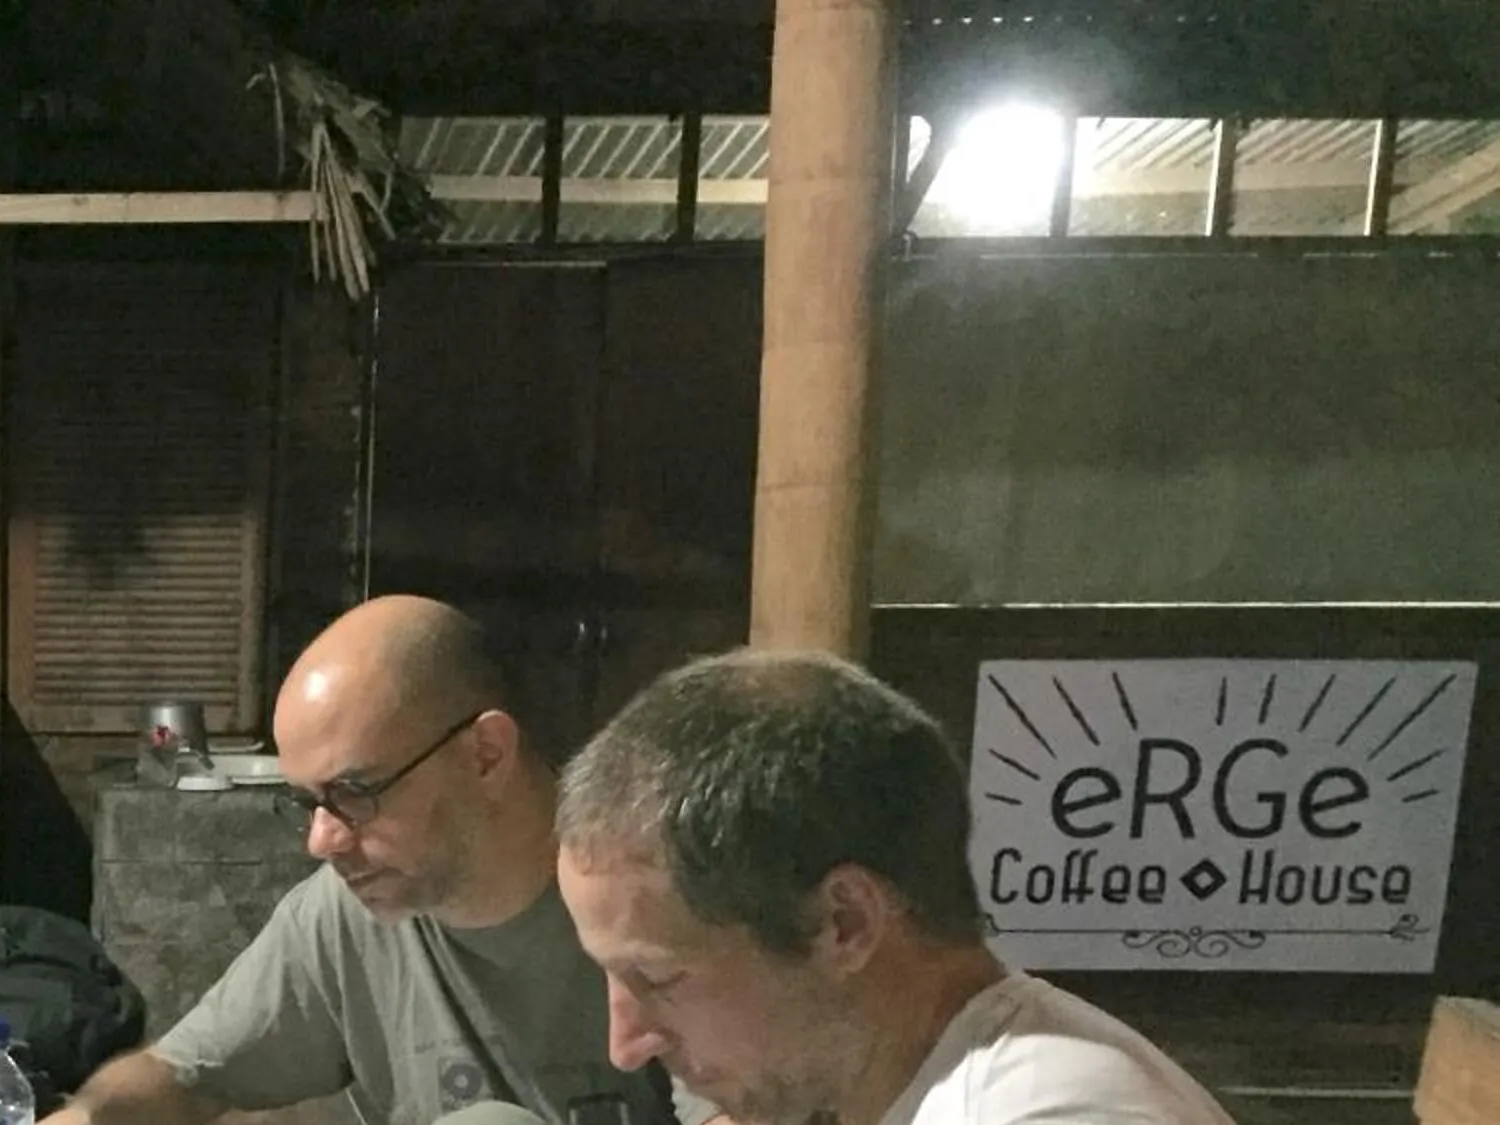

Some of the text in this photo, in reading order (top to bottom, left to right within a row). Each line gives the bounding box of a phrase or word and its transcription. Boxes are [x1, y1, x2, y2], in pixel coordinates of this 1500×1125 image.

[1050, 737, 1370, 840] eRGe
[988, 847, 1412, 906] Coffee House
